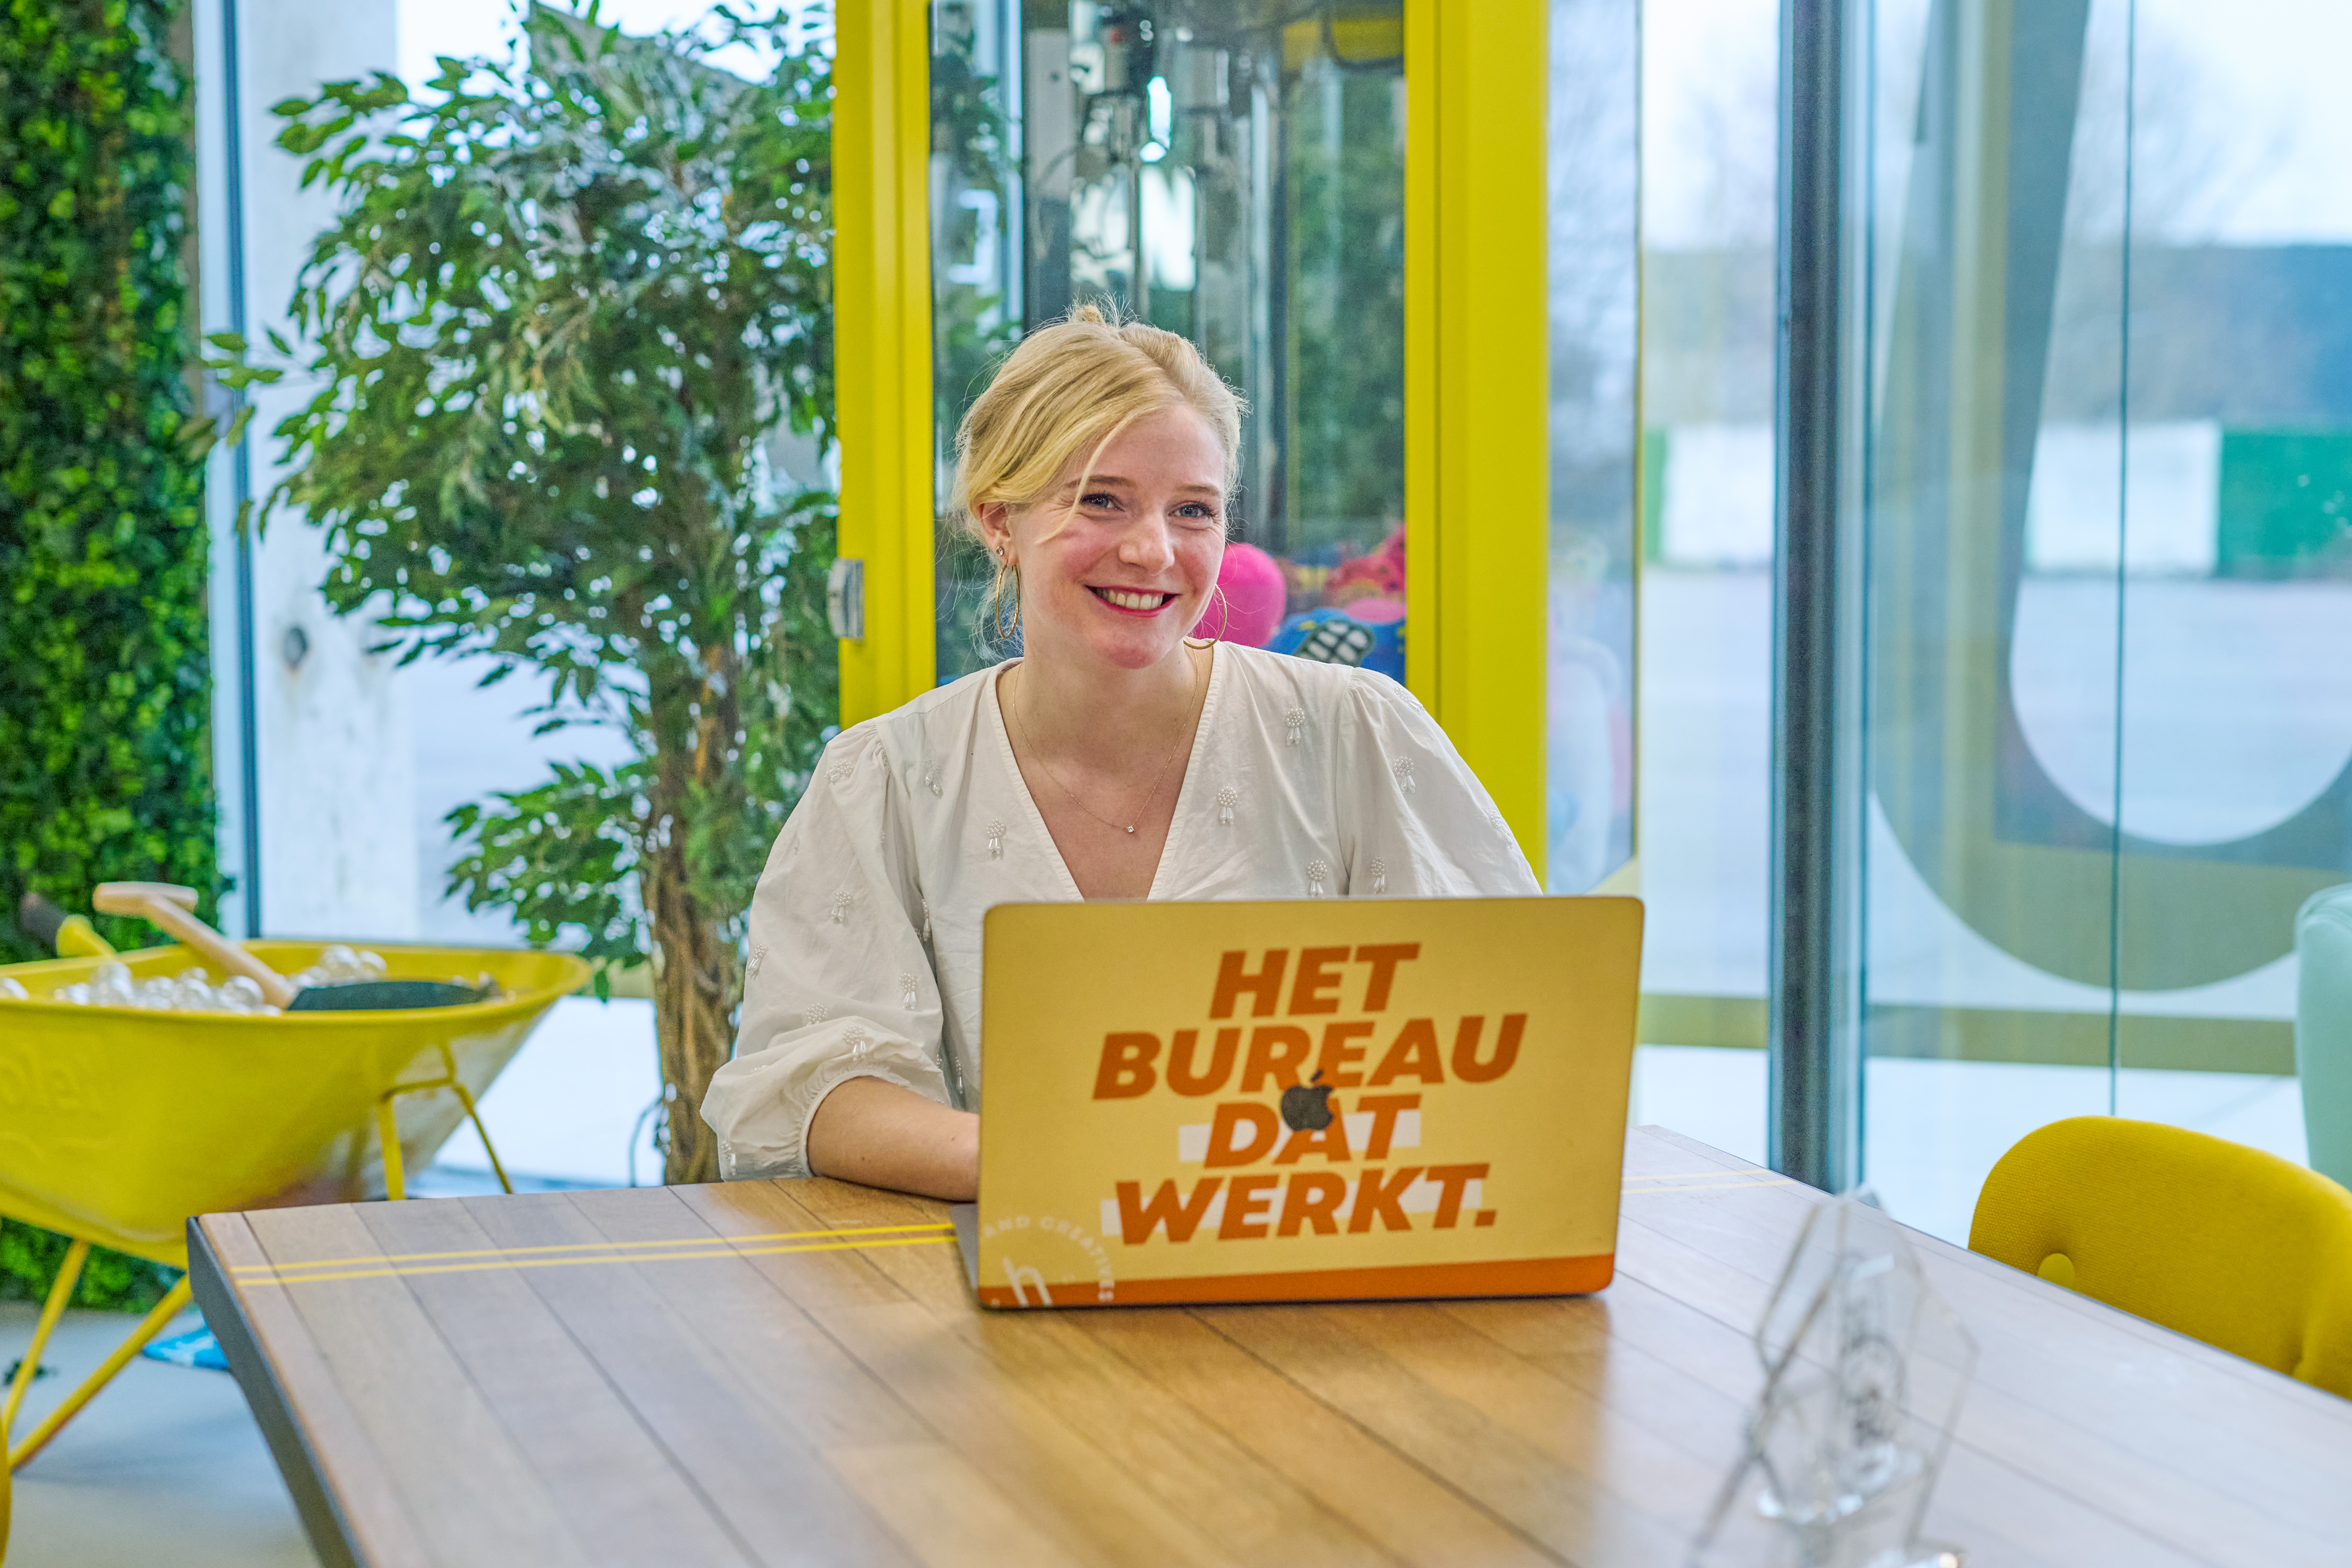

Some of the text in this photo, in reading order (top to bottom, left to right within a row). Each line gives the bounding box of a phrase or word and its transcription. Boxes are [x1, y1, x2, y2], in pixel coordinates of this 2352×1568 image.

[1210, 942, 1420, 1019] HET
[1093, 1013, 1527, 1100] BUREAU
[1205, 1094, 1420, 1168] DAT
[983, 1215, 1030, 1238] AND
[1116, 1163, 1497, 1246] WERKT.
